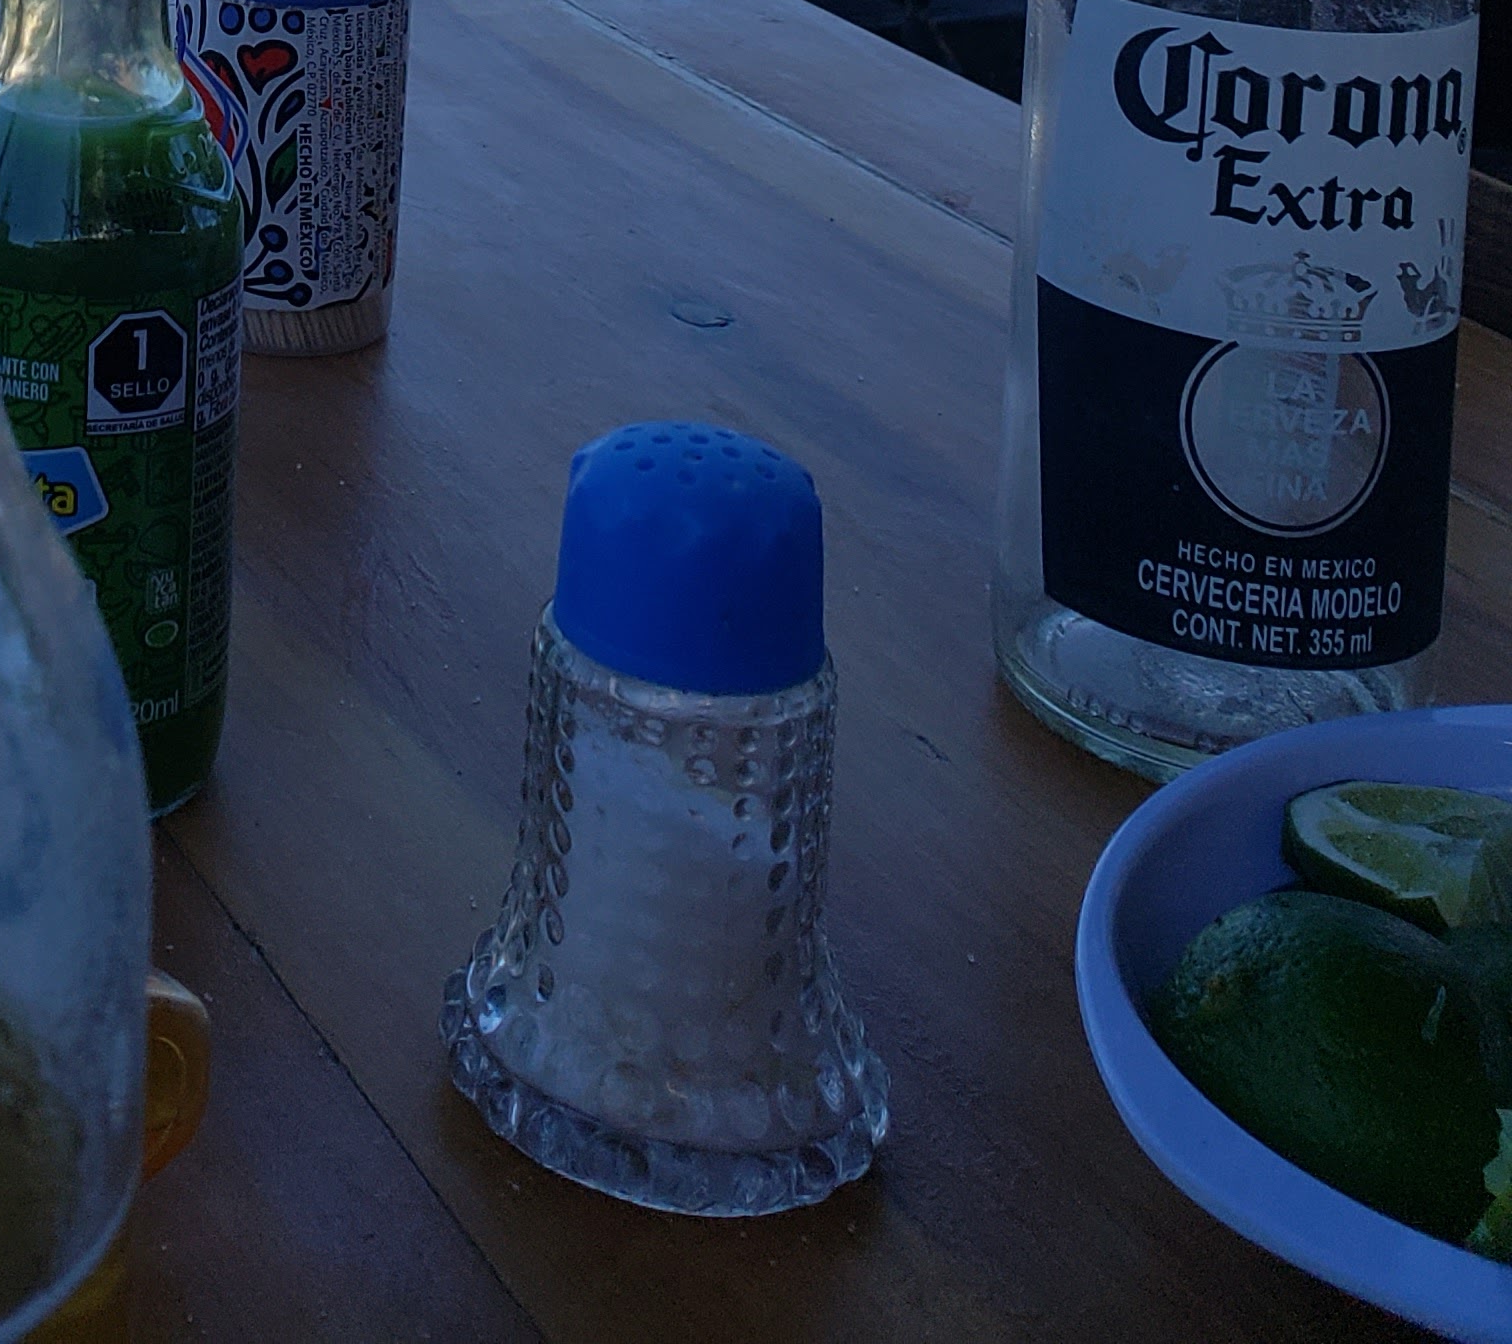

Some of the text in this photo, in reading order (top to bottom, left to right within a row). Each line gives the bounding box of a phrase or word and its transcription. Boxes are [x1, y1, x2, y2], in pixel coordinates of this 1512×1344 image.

[305, 16, 319, 58] México,
[331, 15, 344, 58] México,
[345, 14, 354, 48] Usada
[356, 12, 366, 69] Licenciada
[333, 71, 342, 85] de
[343, 54, 354, 79] bajo
[307, 83, 317, 116] 02770
[1112, 26, 1463, 162] Corona
[345, 86, 355, 145] sublicencia
[318, 109, 329, 180] Azcapotzalco,
[343, 152, 352, 170] por
[299, 123, 316, 269] HECHO EN MÉXICO
[320, 188, 332, 224] Ciudad
[1210, 146, 1415, 232] Extra
[320, 232, 330, 246] de
[134, 329, 147, 371] 1
[30, 361, 60, 383] CON
[110, 377, 170, 399] SELLO
[1267, 371, 1317, 400] LA
[145, 419, 158, 429] DE
[1178, 538, 1376, 580] HECHO EN MEXICO
[1137, 558, 1402, 621] CERVECERIA MODELO
[1172, 608, 1373, 656] CONT. NET. 355 ml
